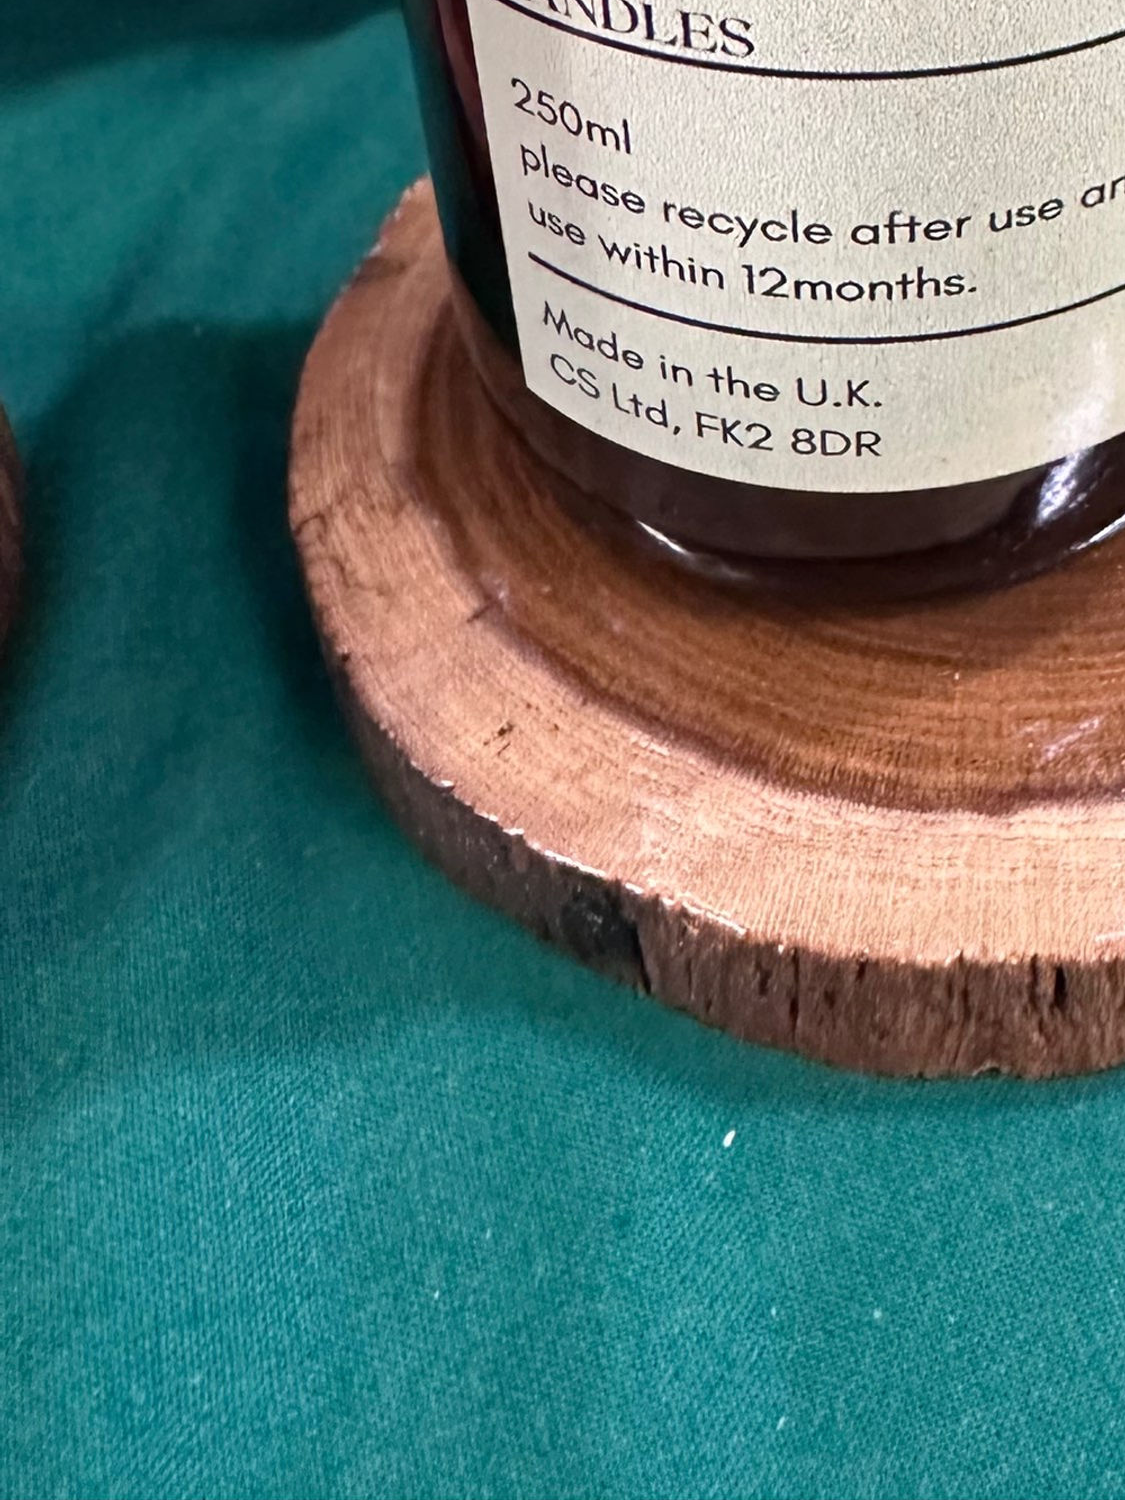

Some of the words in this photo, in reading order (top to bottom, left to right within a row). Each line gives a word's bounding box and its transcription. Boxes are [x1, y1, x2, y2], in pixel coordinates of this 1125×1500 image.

[511, 77, 632, 155] 250ml
[520, 144, 645, 214] please
[663, 200, 832, 248] recycle
[850, 210, 972, 245] after
[989, 198, 1064, 232] use
[528, 202, 587, 247] use
[599, 234, 725, 290] within
[741, 263, 978, 303] 12months.
[543, 301, 644, 370] Made
[659, 354, 694, 388] in
[706, 365, 781, 403] the
[795, 377, 883, 408] U.K.
[549, 353, 601, 400] CS
[612, 382, 682, 436] Ltd,
[695, 411, 774, 451] FK2
[790, 427, 882, 458] 8DR
